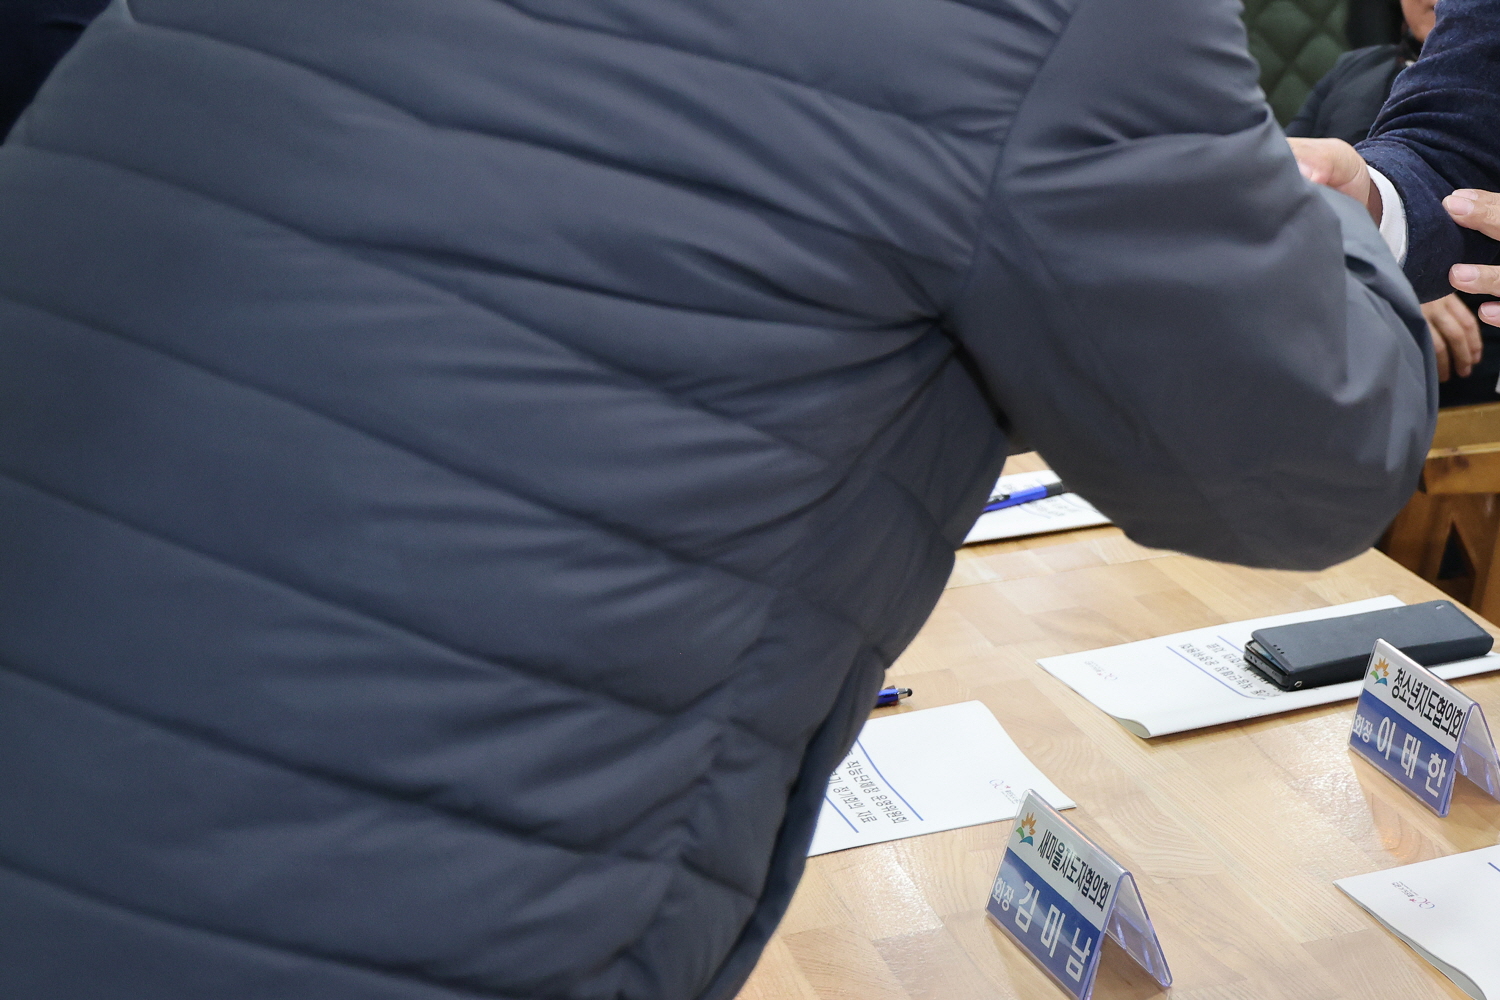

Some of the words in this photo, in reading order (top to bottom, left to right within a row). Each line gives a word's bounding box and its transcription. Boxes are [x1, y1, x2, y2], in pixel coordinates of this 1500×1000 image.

[1352, 713, 1373, 744] 회장
[1392, 668, 1466, 742] 청소년지도협의회
[833, 786, 866, 809] 정기회의
[855, 810, 878, 824] 자료
[846, 760, 881, 794] 직능단체장
[871, 794, 909, 824] 운영위원회
[992, 877, 1014, 912] 회장
[1037, 829, 1111, 912] 새마을지도자협의회
